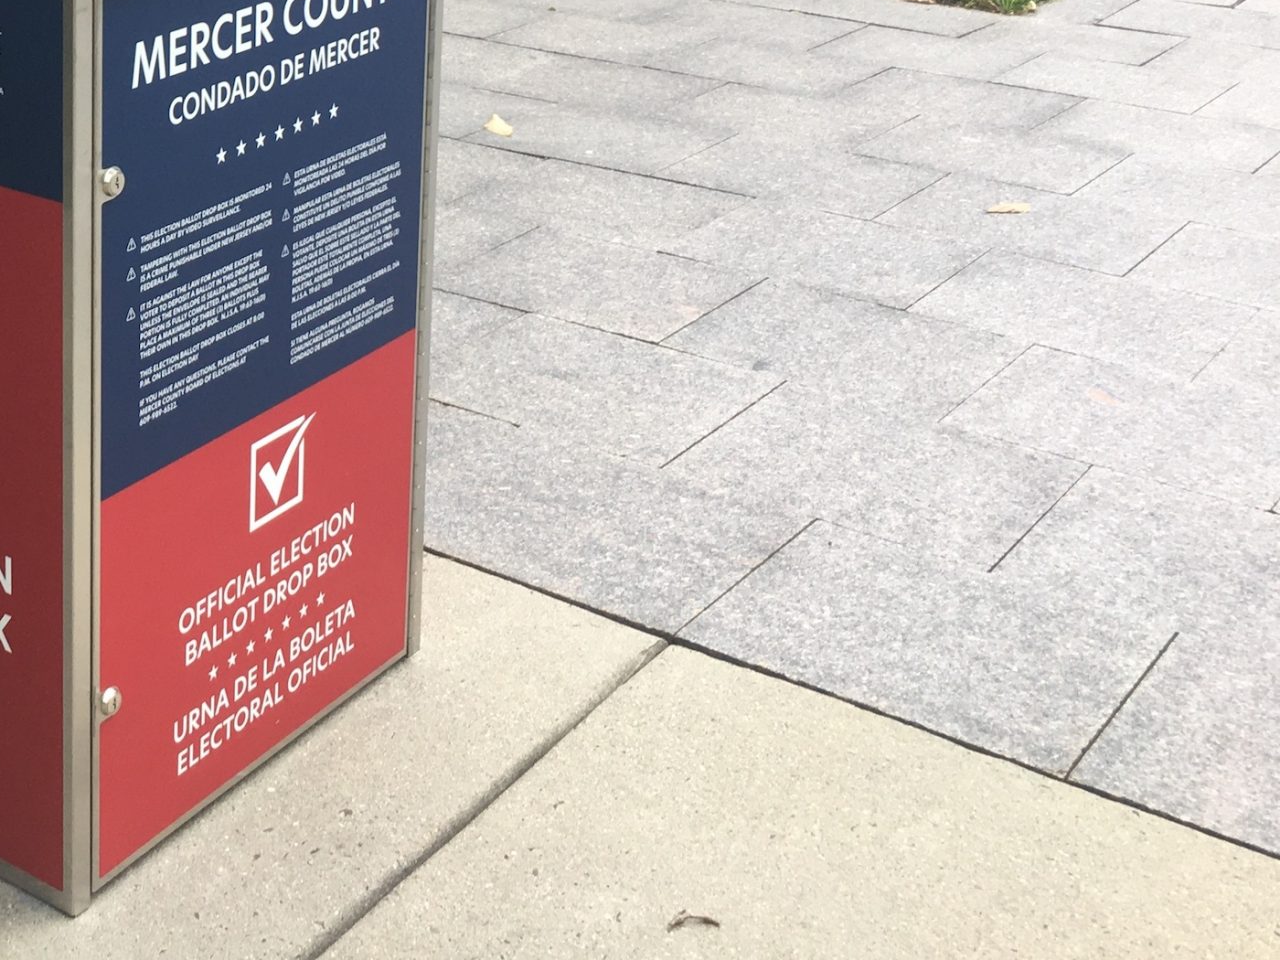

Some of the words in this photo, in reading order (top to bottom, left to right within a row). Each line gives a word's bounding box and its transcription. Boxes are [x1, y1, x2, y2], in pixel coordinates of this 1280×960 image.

[131, 1, 274, 90] MERCER
[168, 64, 276, 125] CONDADO
[280, 52, 305, 86] DE
[308, 26, 381, 75] MERCER
[141, 231, 153, 243] THIS
[154, 220, 180, 238] ELECTION
[181, 212, 201, 227] BALLOT
[201, 206, 216, 218] DROP
[217, 201, 228, 212] BOX
[234, 186, 265, 205] MONITORED
[141, 238, 160, 253] HOURS
[165, 231, 176, 243] DAY
[185, 221, 202, 235] VIDEO
[141, 252, 172, 272] TAMPERING
[173, 246, 188, 259] WITH
[188, 240, 200, 252] THIS
[200, 230, 226, 247] ELECTION
[226, 222, 245, 236] BALLOT
[246, 215, 260, 228] DROP
[260, 210, 272, 222] BOX
[151, 263, 168, 277] CRIME
[169, 249, 202, 270] PUNISHABLE
[202, 241, 220, 256] UNDER
[221, 236, 234, 248] NEW
[234, 229, 251, 243] JERSEY
[140, 276, 164, 292] FEDERAL
[178, 562, 266, 635] OFFICIAL
[270, 502, 355, 577] ELECTION
[185, 596, 260, 667] BALLOT
[263, 562, 314, 614] DROP
[316, 534, 353, 578] BOX
[173, 687, 230, 744] URNA
[233, 664, 258, 702] DE
[262, 648, 286, 682] LA
[289, 599, 356, 663] BOLETA
[177, 681, 284, 776] ELECTORAL
[287, 630, 355, 693] OFICIAL
